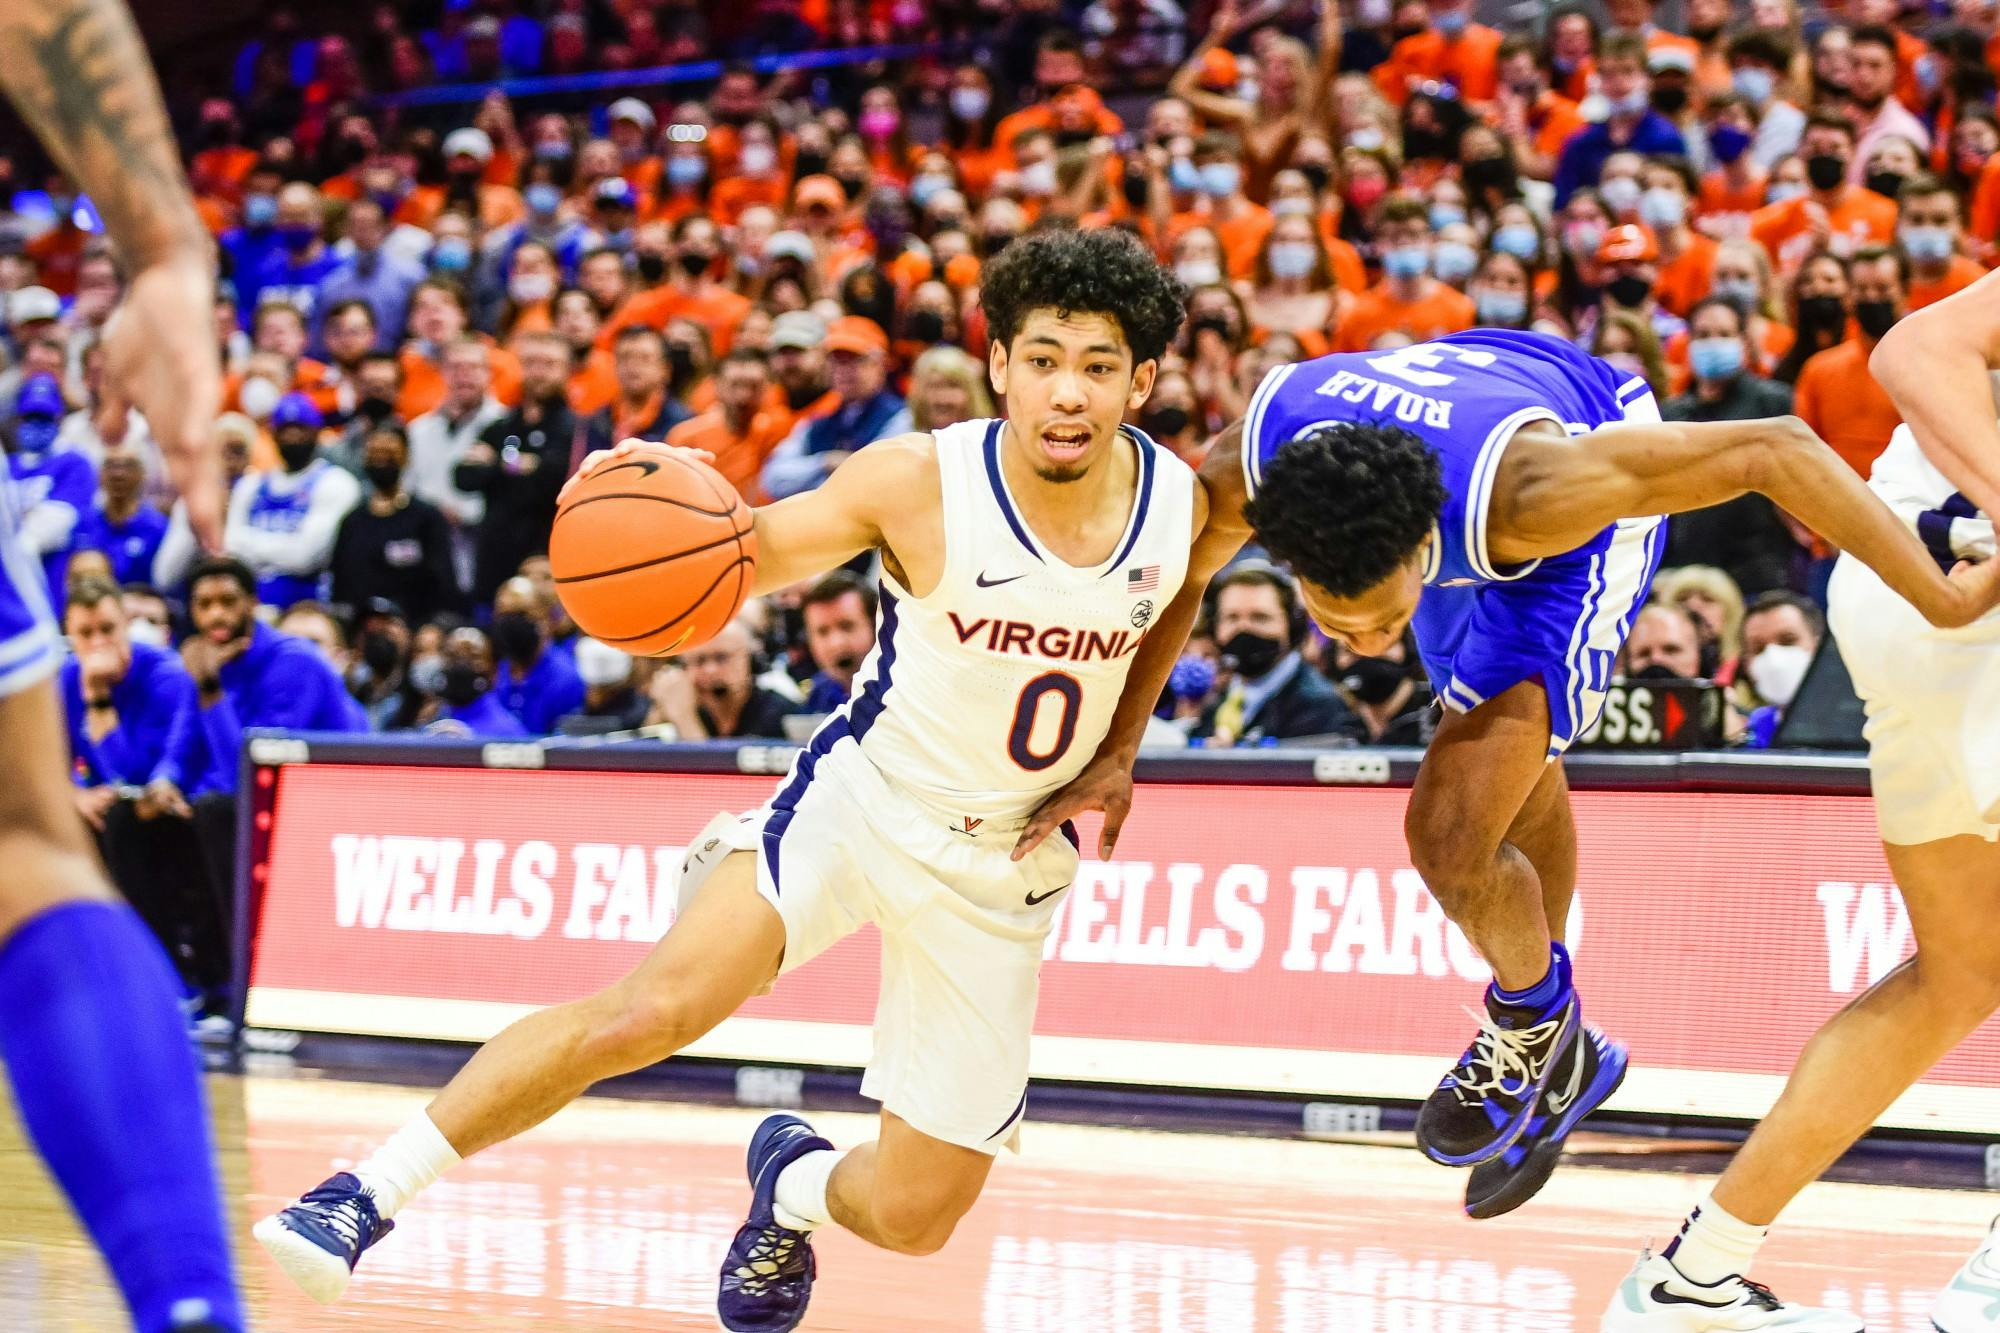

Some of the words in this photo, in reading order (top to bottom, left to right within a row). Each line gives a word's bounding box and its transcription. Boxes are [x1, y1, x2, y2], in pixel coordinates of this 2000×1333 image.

[1314, 370, 1454, 430] ROACH
[1007, 669, 1083, 772] 0
[331, 833, 557, 940] WELLS
[1043, 859, 1269, 973] ELLS
[1281, 866, 1583, 982] FAR
